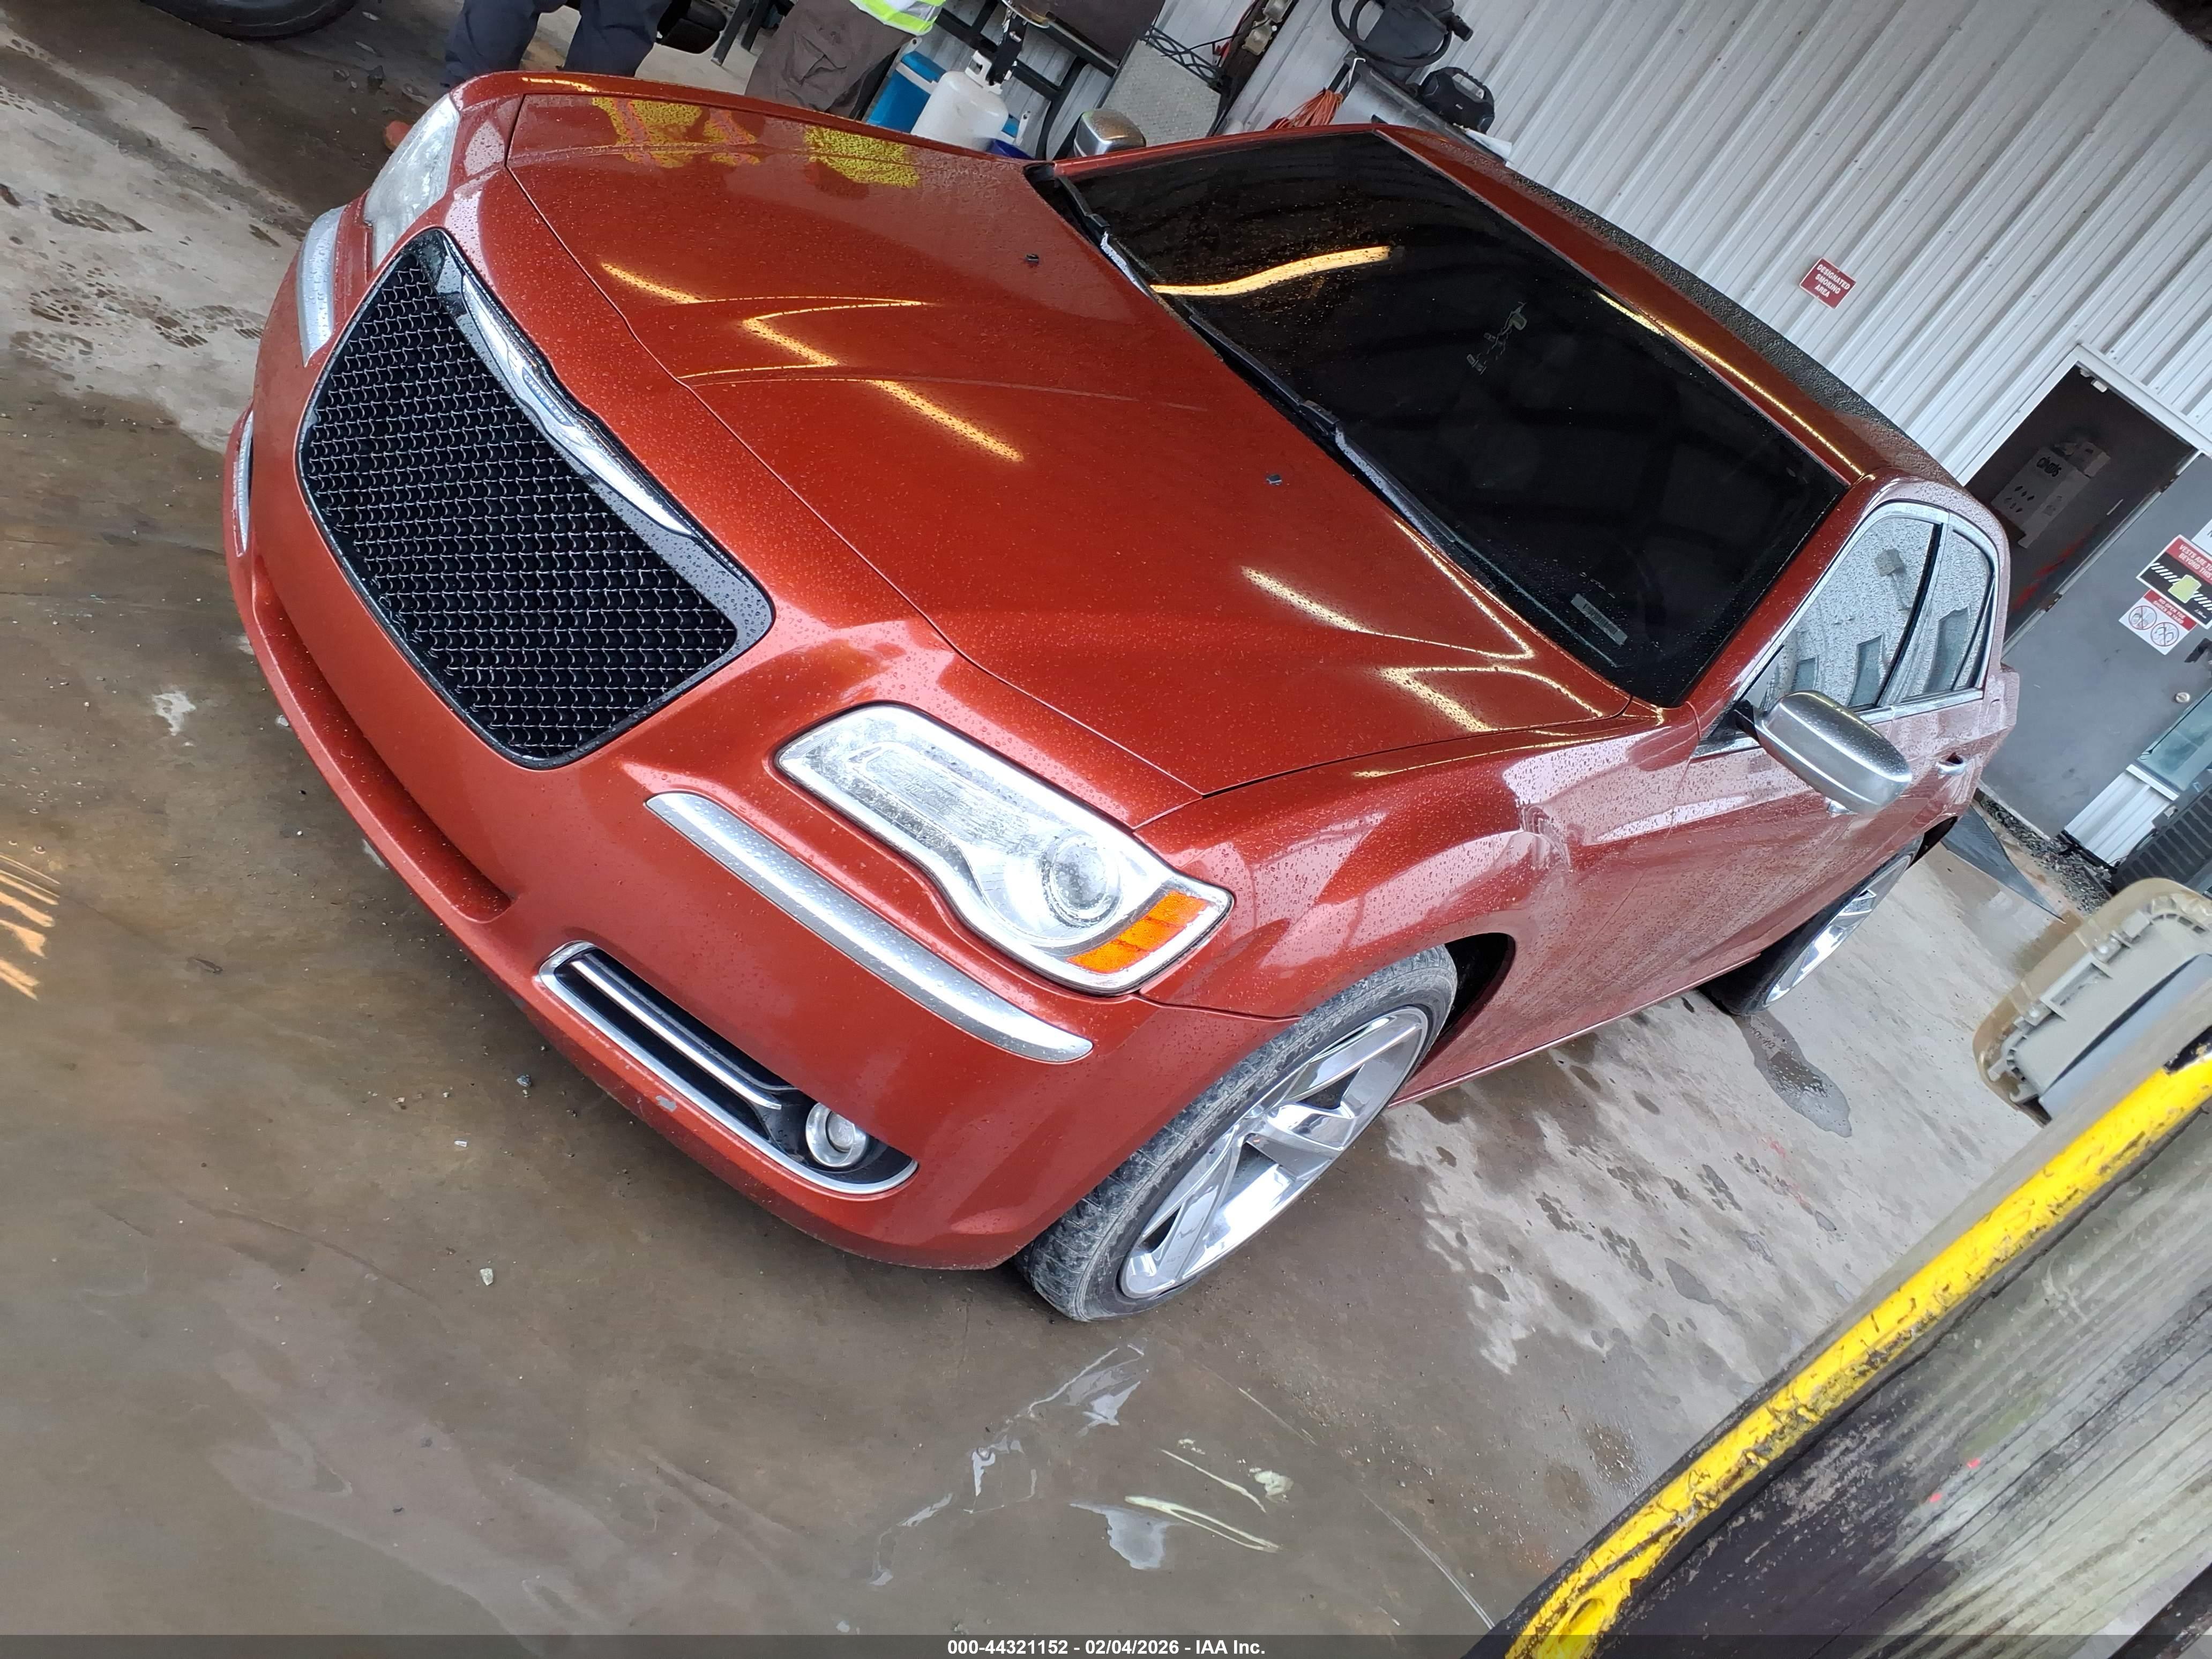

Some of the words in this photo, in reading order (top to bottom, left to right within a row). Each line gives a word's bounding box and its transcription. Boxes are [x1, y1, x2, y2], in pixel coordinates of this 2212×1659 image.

[1815, 274, 1841, 294] SMOKING
[1817, 264, 1850, 290] DESIGNATED
[1814, 284, 1830, 298] AREA
[524, 375, 566, 422] CHRYSLER
[2178, 553, 2200, 570] BEYOND
[2199, 567, 2211, 578] THIS
[2179, 544, 2197, 558] VESTS
[2195, 556, 2207, 566] ARE
[2165, 603, 2178, 614] OPEN
[2177, 611, 2186, 619] TOE
